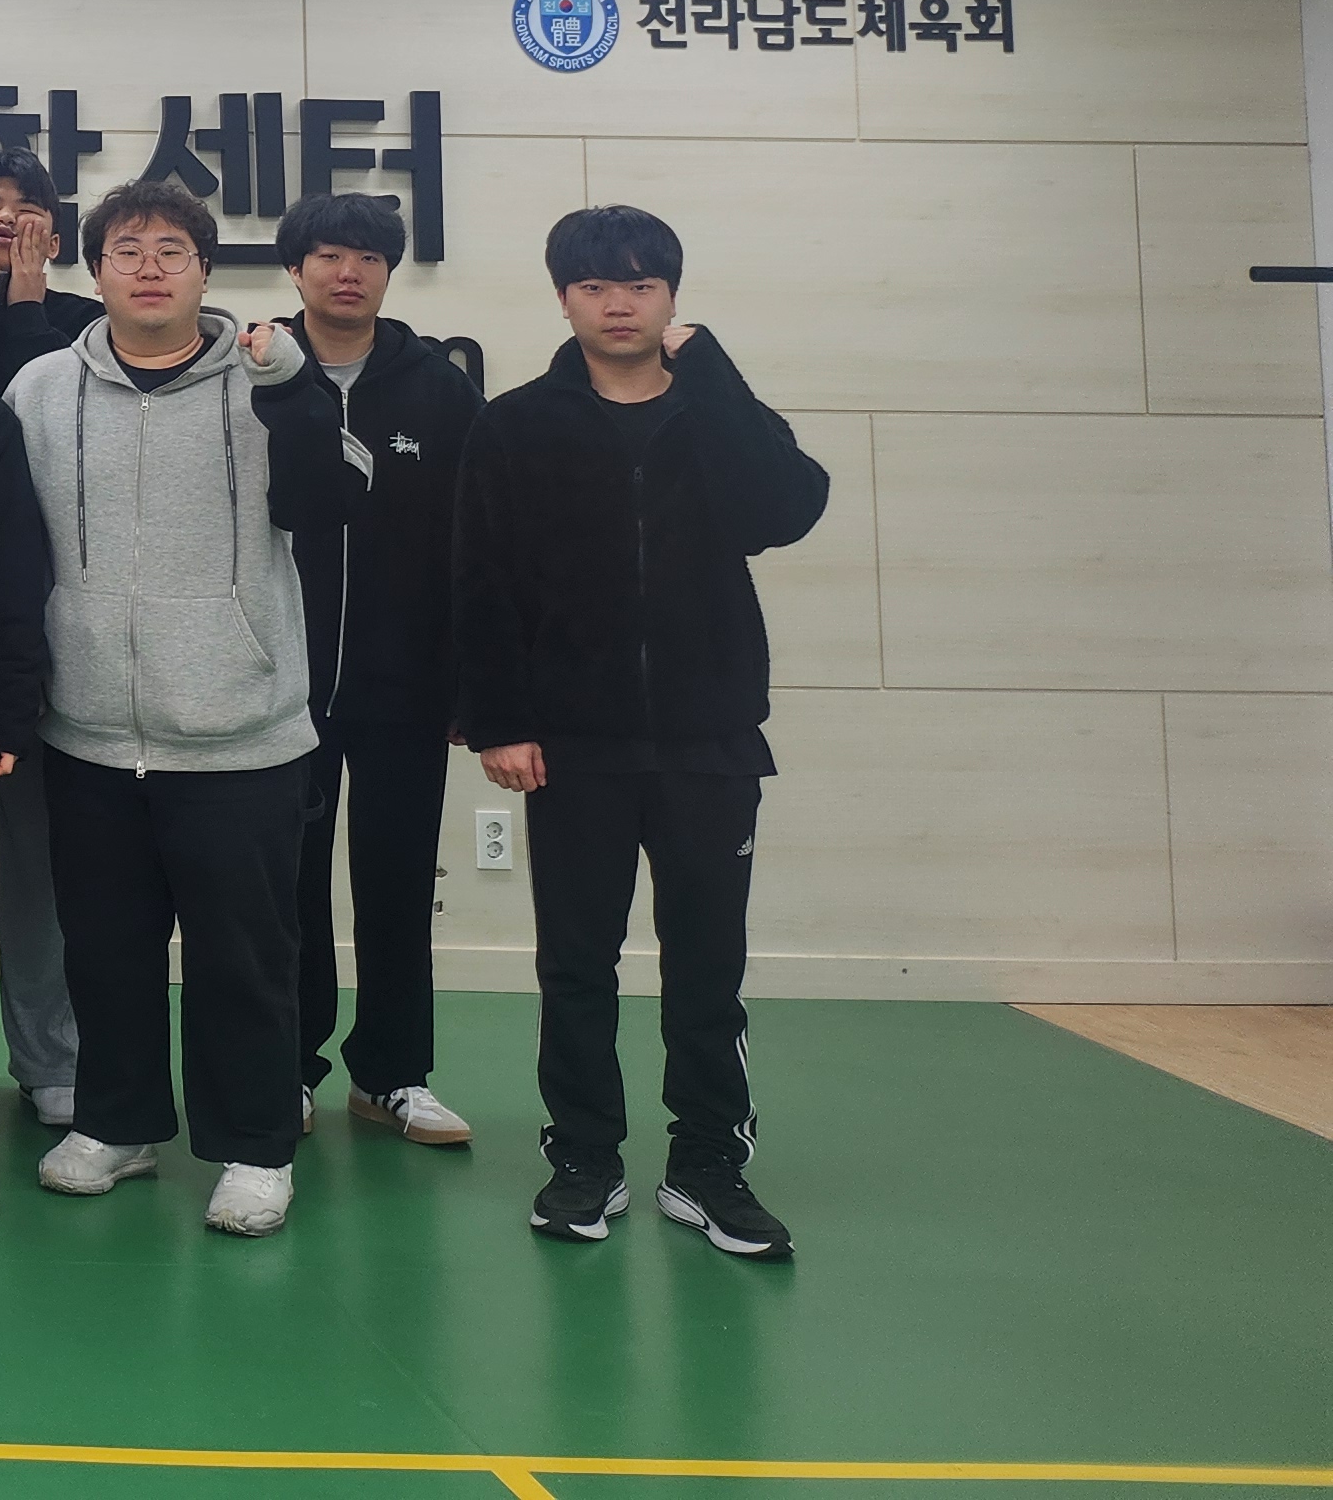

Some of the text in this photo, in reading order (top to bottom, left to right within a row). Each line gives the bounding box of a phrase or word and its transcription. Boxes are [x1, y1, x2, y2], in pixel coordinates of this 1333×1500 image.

[515, 10, 618, 70] JEONNAM SPORTS COUNCIL
